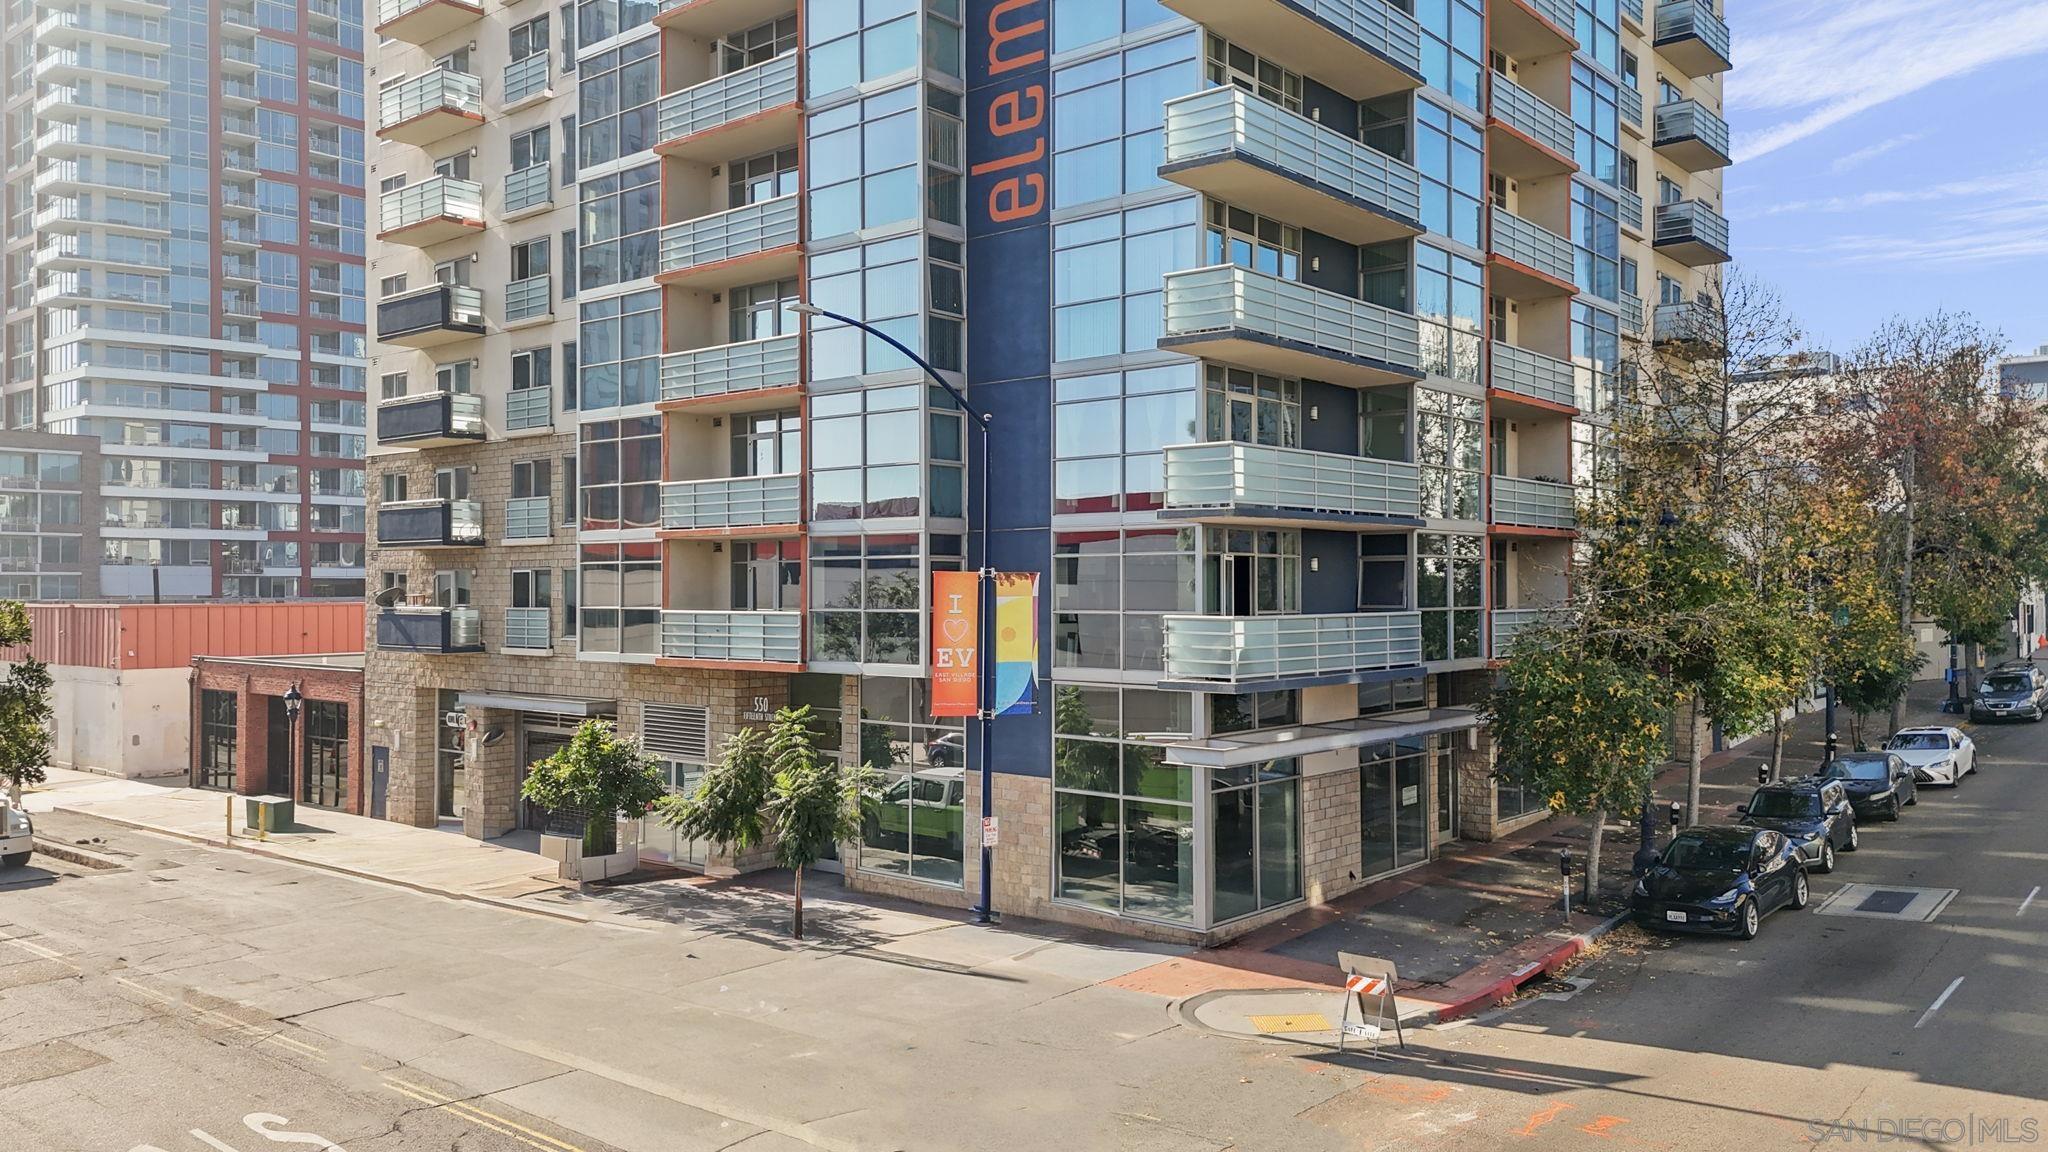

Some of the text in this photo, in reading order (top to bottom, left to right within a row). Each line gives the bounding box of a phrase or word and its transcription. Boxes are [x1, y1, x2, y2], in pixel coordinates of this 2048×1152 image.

[949, 594, 962, 614] I
[936, 647, 975, 668] EV
[754, 696, 768, 712] 550
